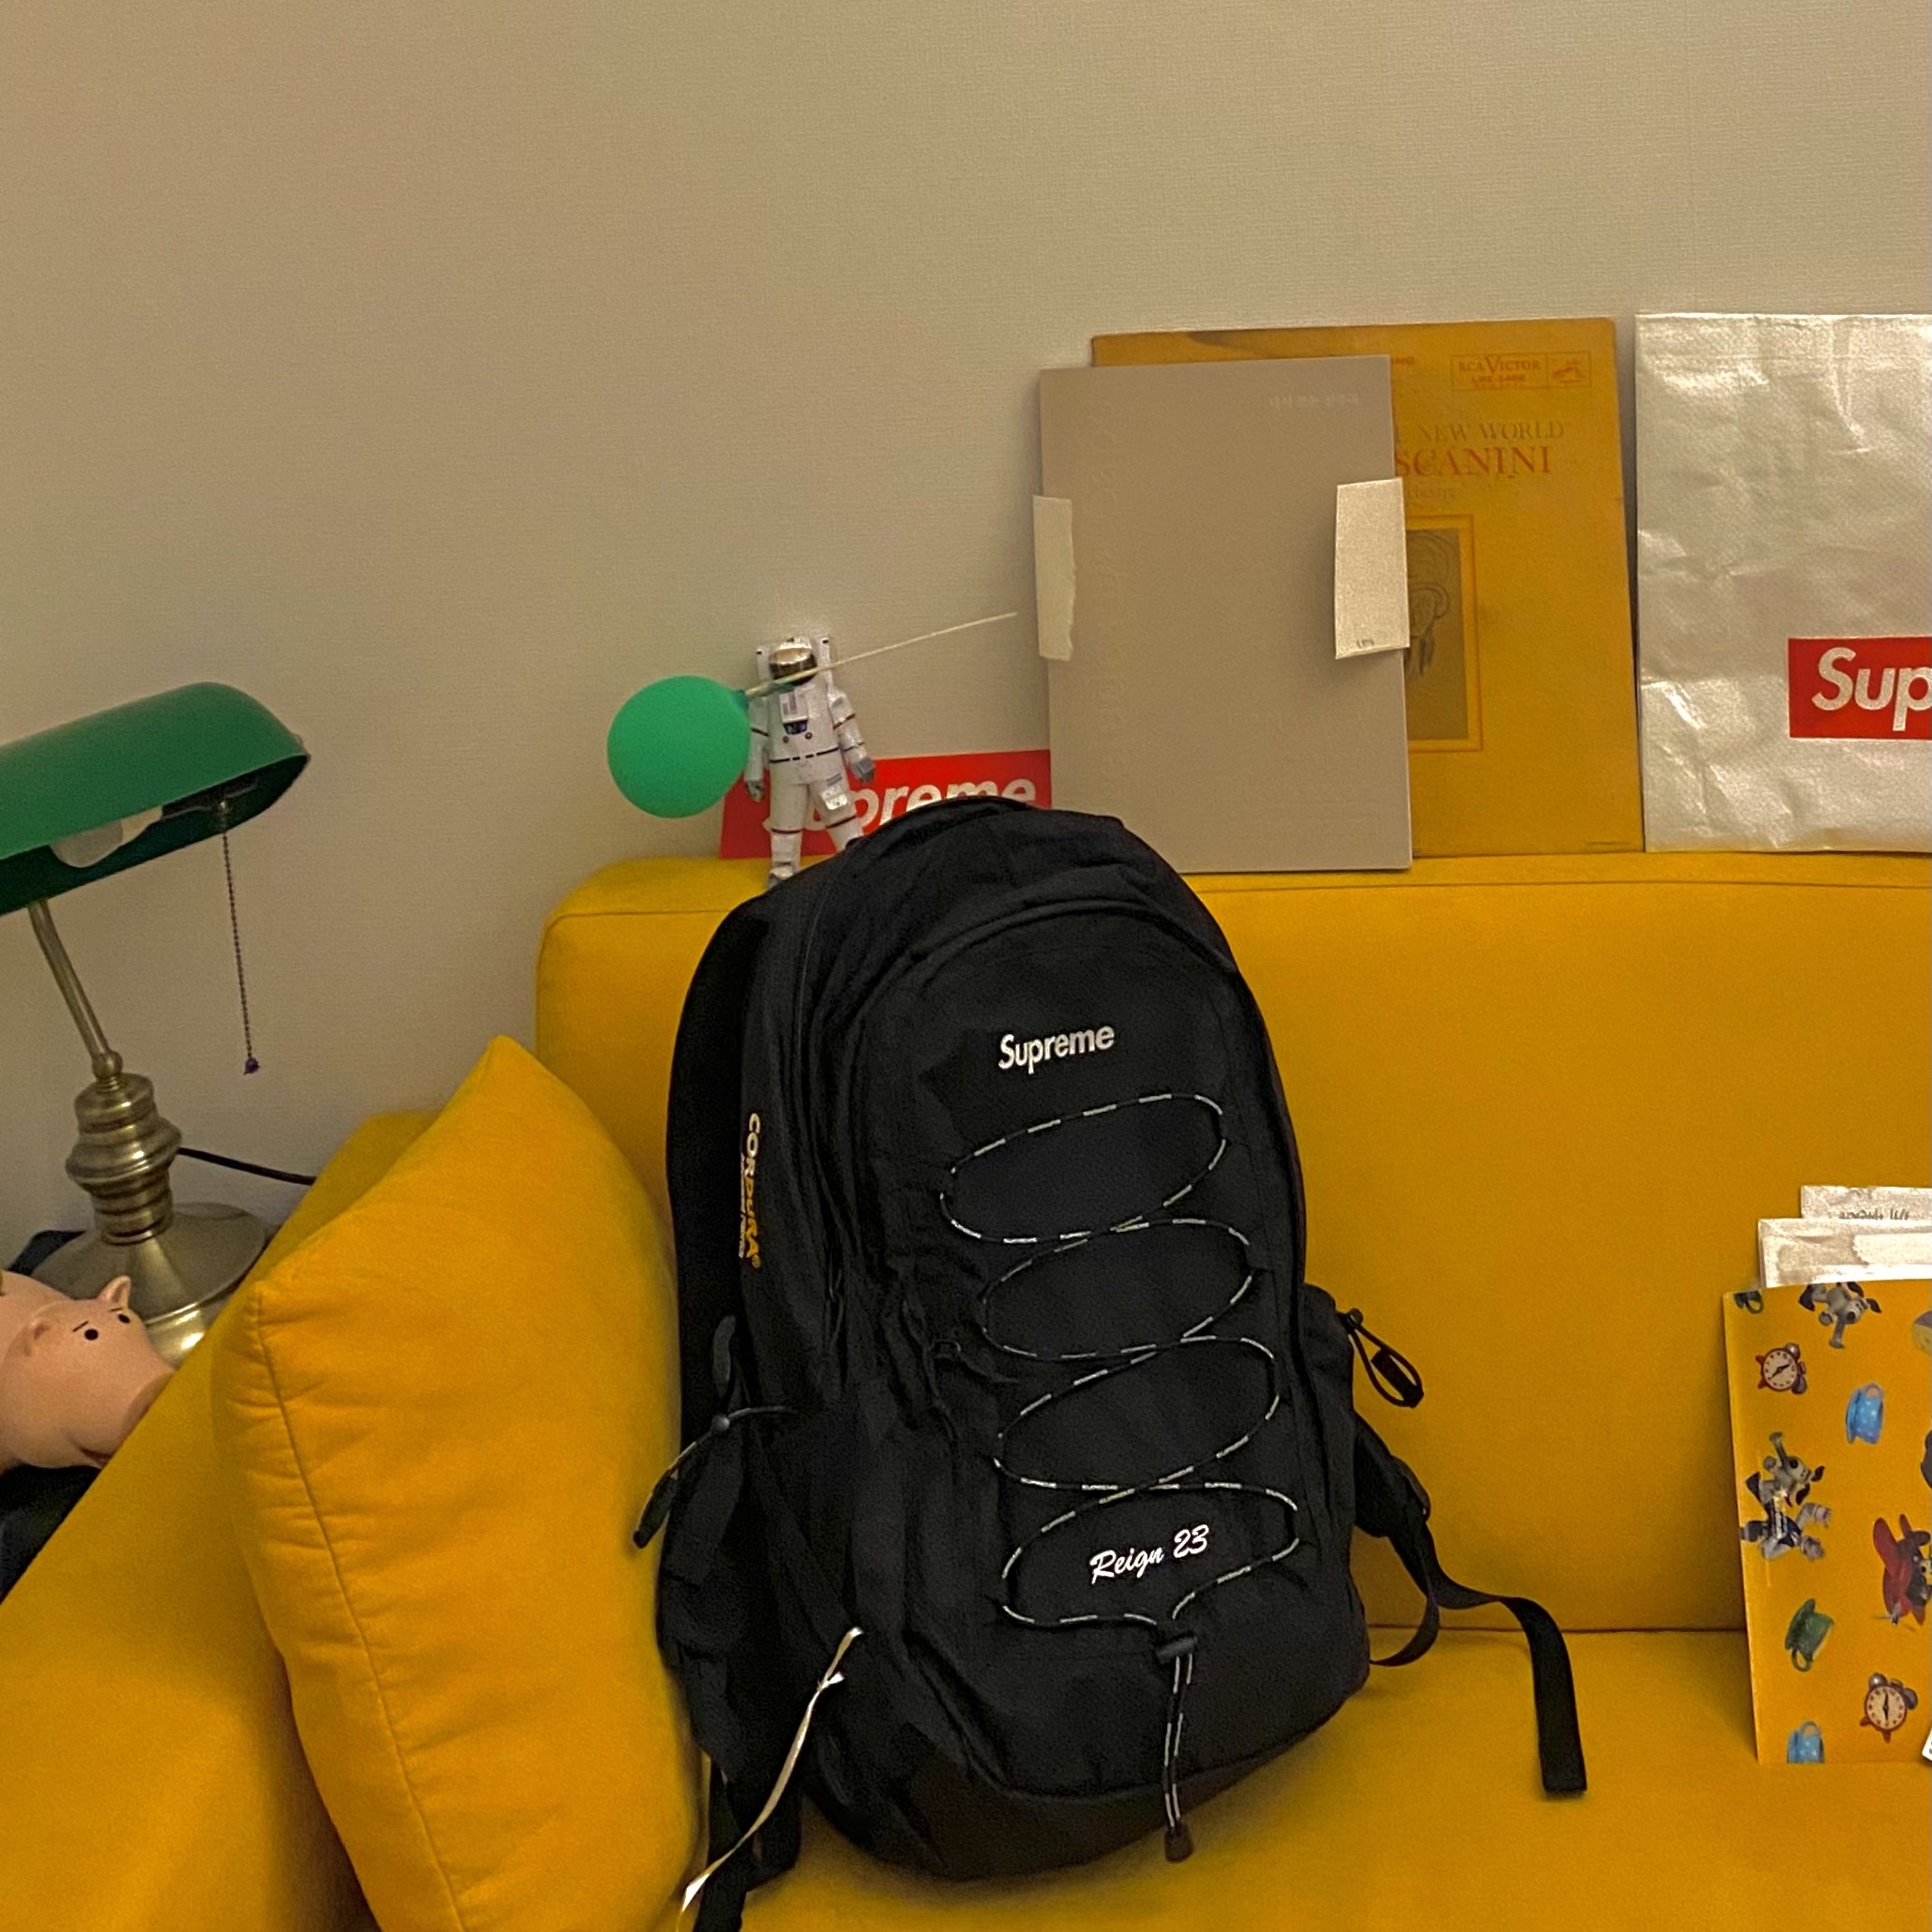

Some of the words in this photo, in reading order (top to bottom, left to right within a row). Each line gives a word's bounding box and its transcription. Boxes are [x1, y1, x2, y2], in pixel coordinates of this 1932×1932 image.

[1417, 423, 1470, 442] NEW
[1811, 646, 1932, 732] Sup
[997, 1025, 1116, 1075] Supreme
[1089, 1547, 1164, 1585] Reign
[1173, 1523, 1210, 1559] 23
